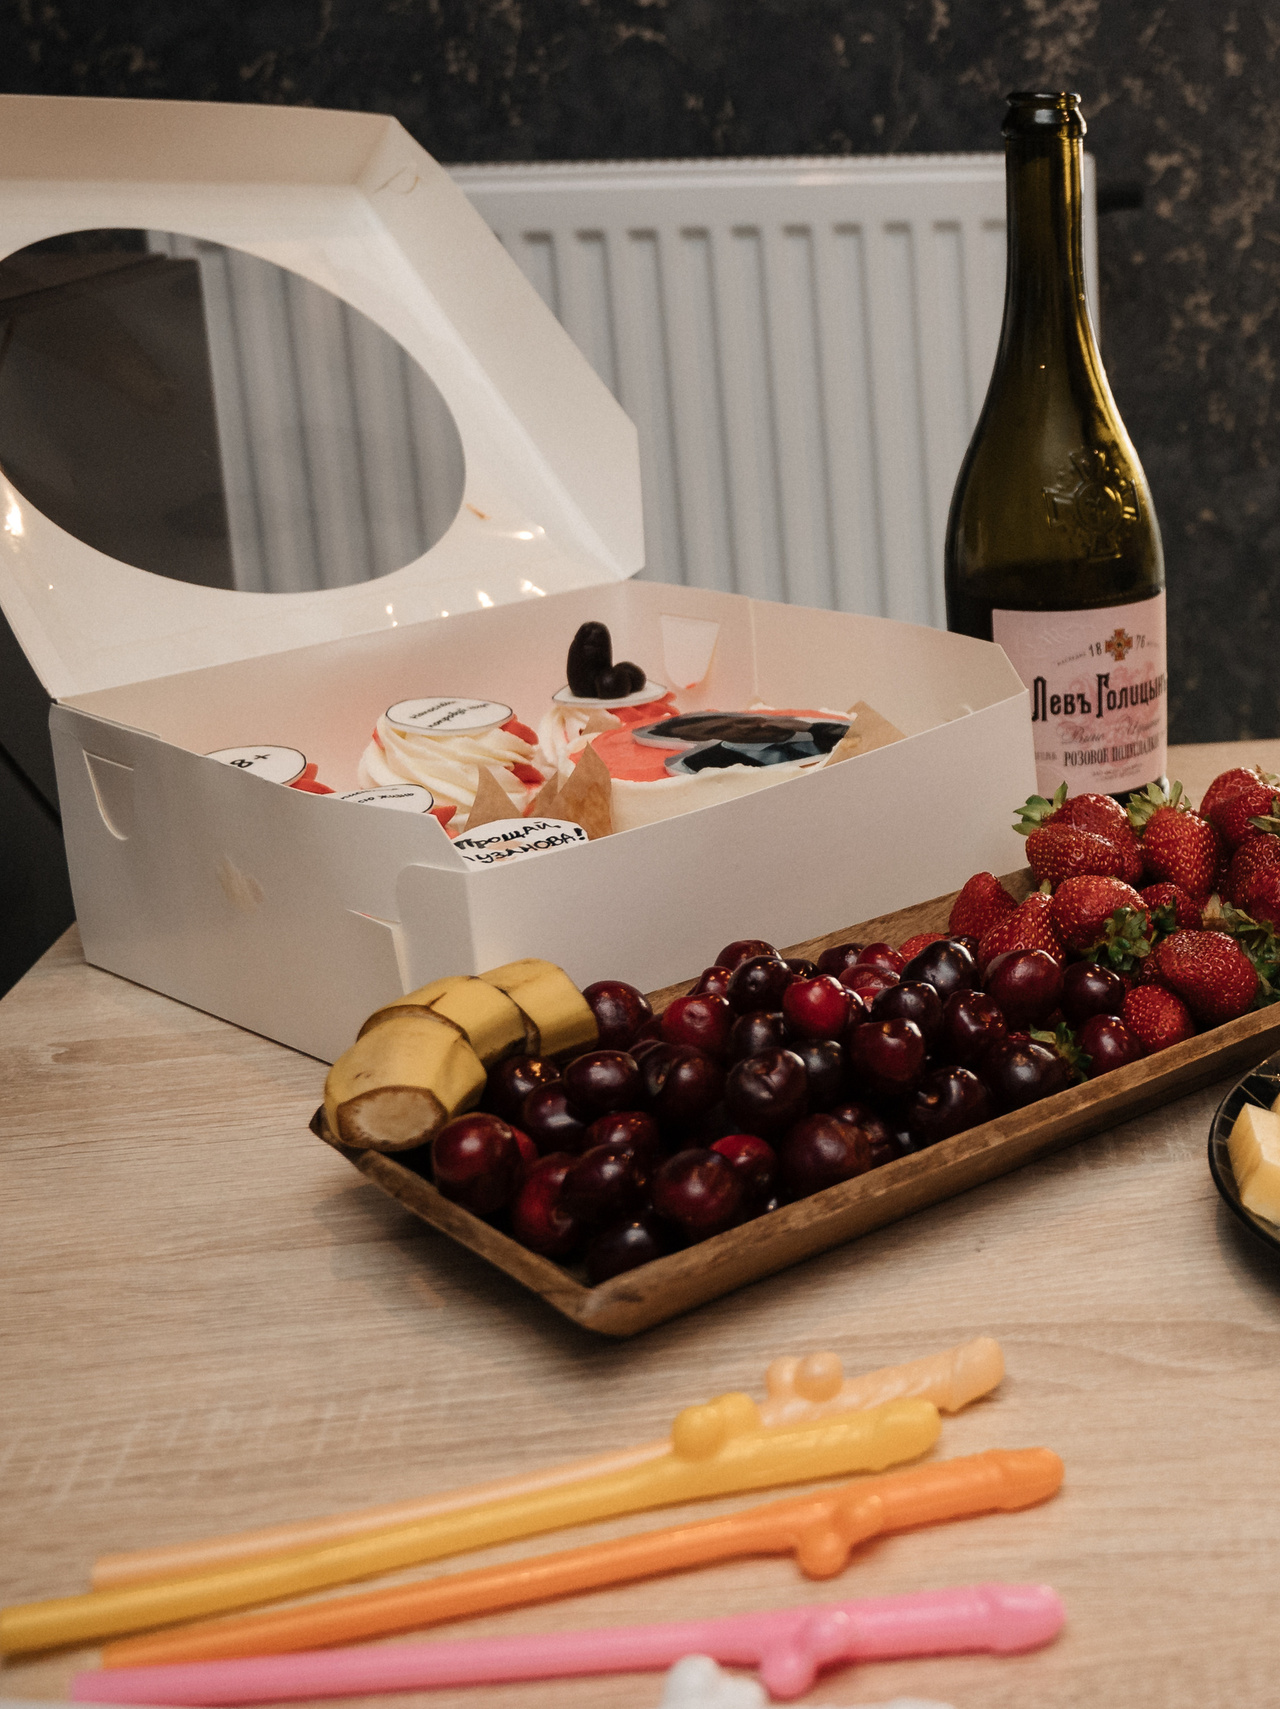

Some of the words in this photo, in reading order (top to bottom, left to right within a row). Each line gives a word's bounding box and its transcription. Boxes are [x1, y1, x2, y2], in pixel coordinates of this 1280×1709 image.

[1088, 642, 1102, 657] 18
[1031, 676, 1091, 722] Левъ
[1064, 747, 1109, 767] РОЗОВОЕ
[357, 796, 375, 804] сю
